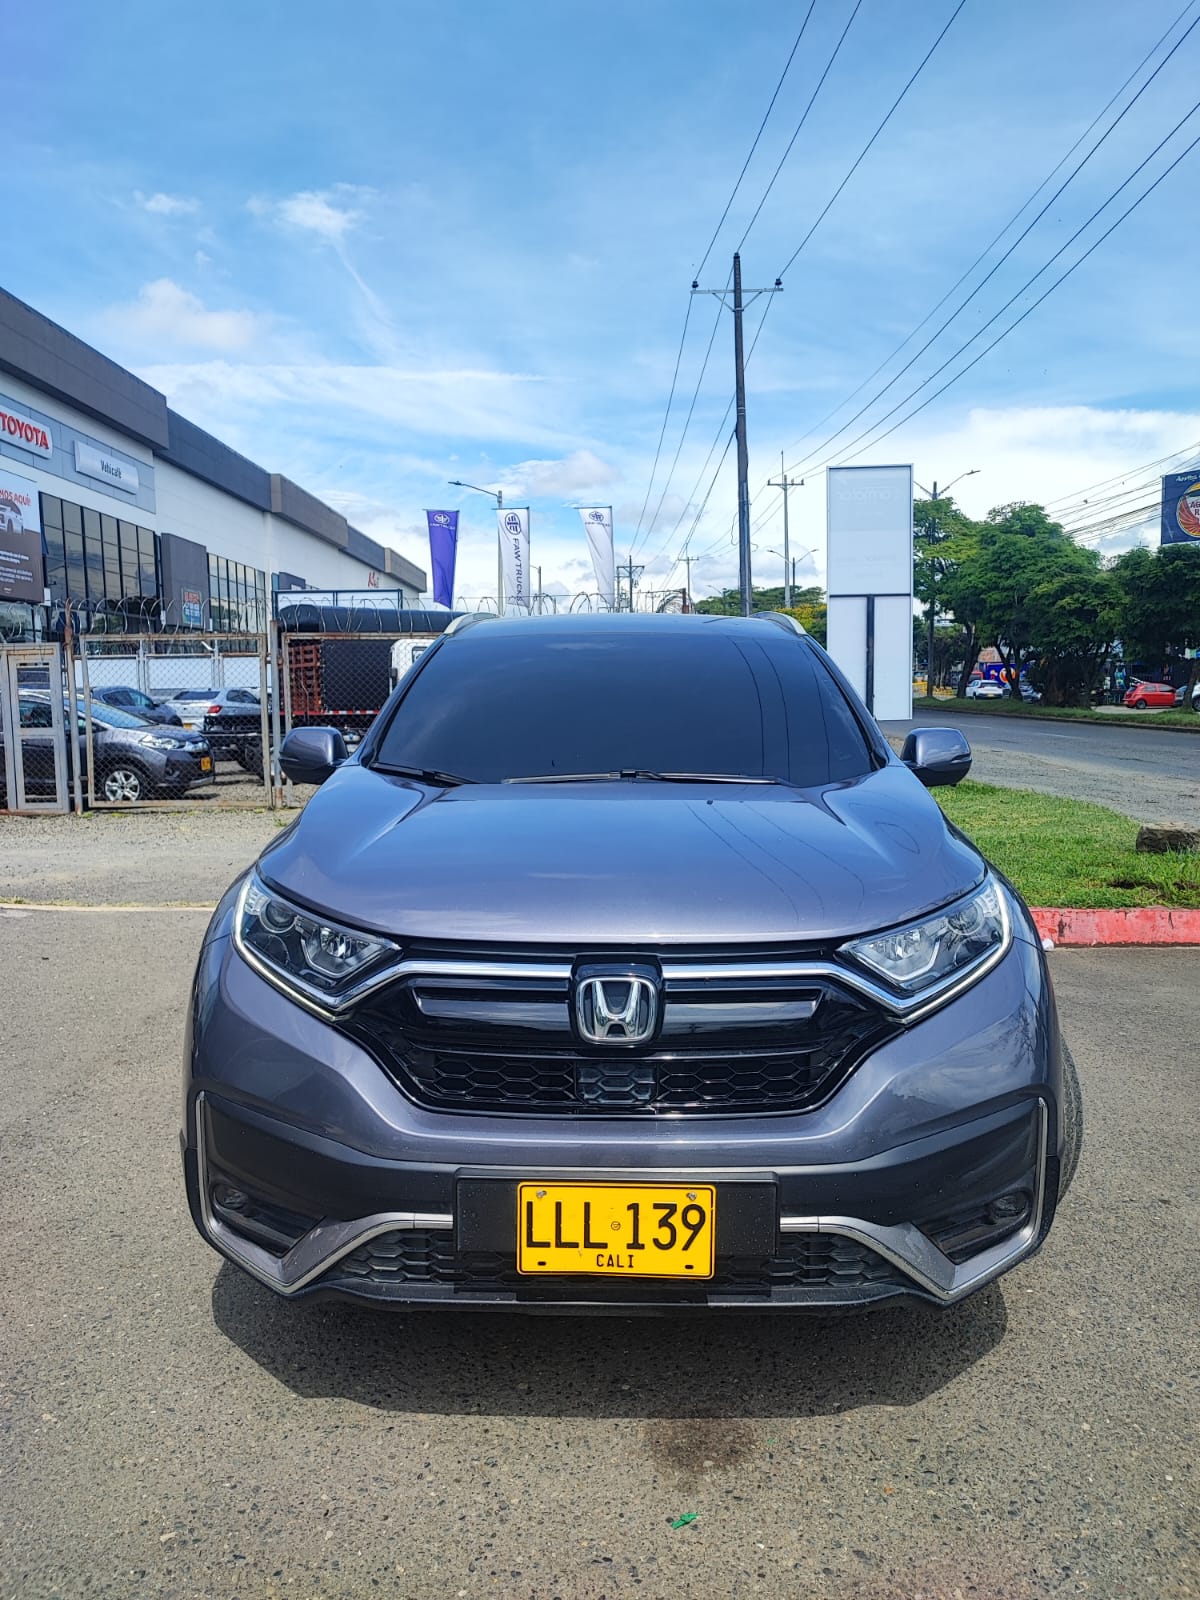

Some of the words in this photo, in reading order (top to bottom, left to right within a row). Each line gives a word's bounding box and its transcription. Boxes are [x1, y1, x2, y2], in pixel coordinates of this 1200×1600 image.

[0, 411, 49, 450] TOYOTA
[526, 1201, 608, 1249] LLL
[626, 1202, 706, 1251] 139
[596, 1254, 634, 1268] CALI
